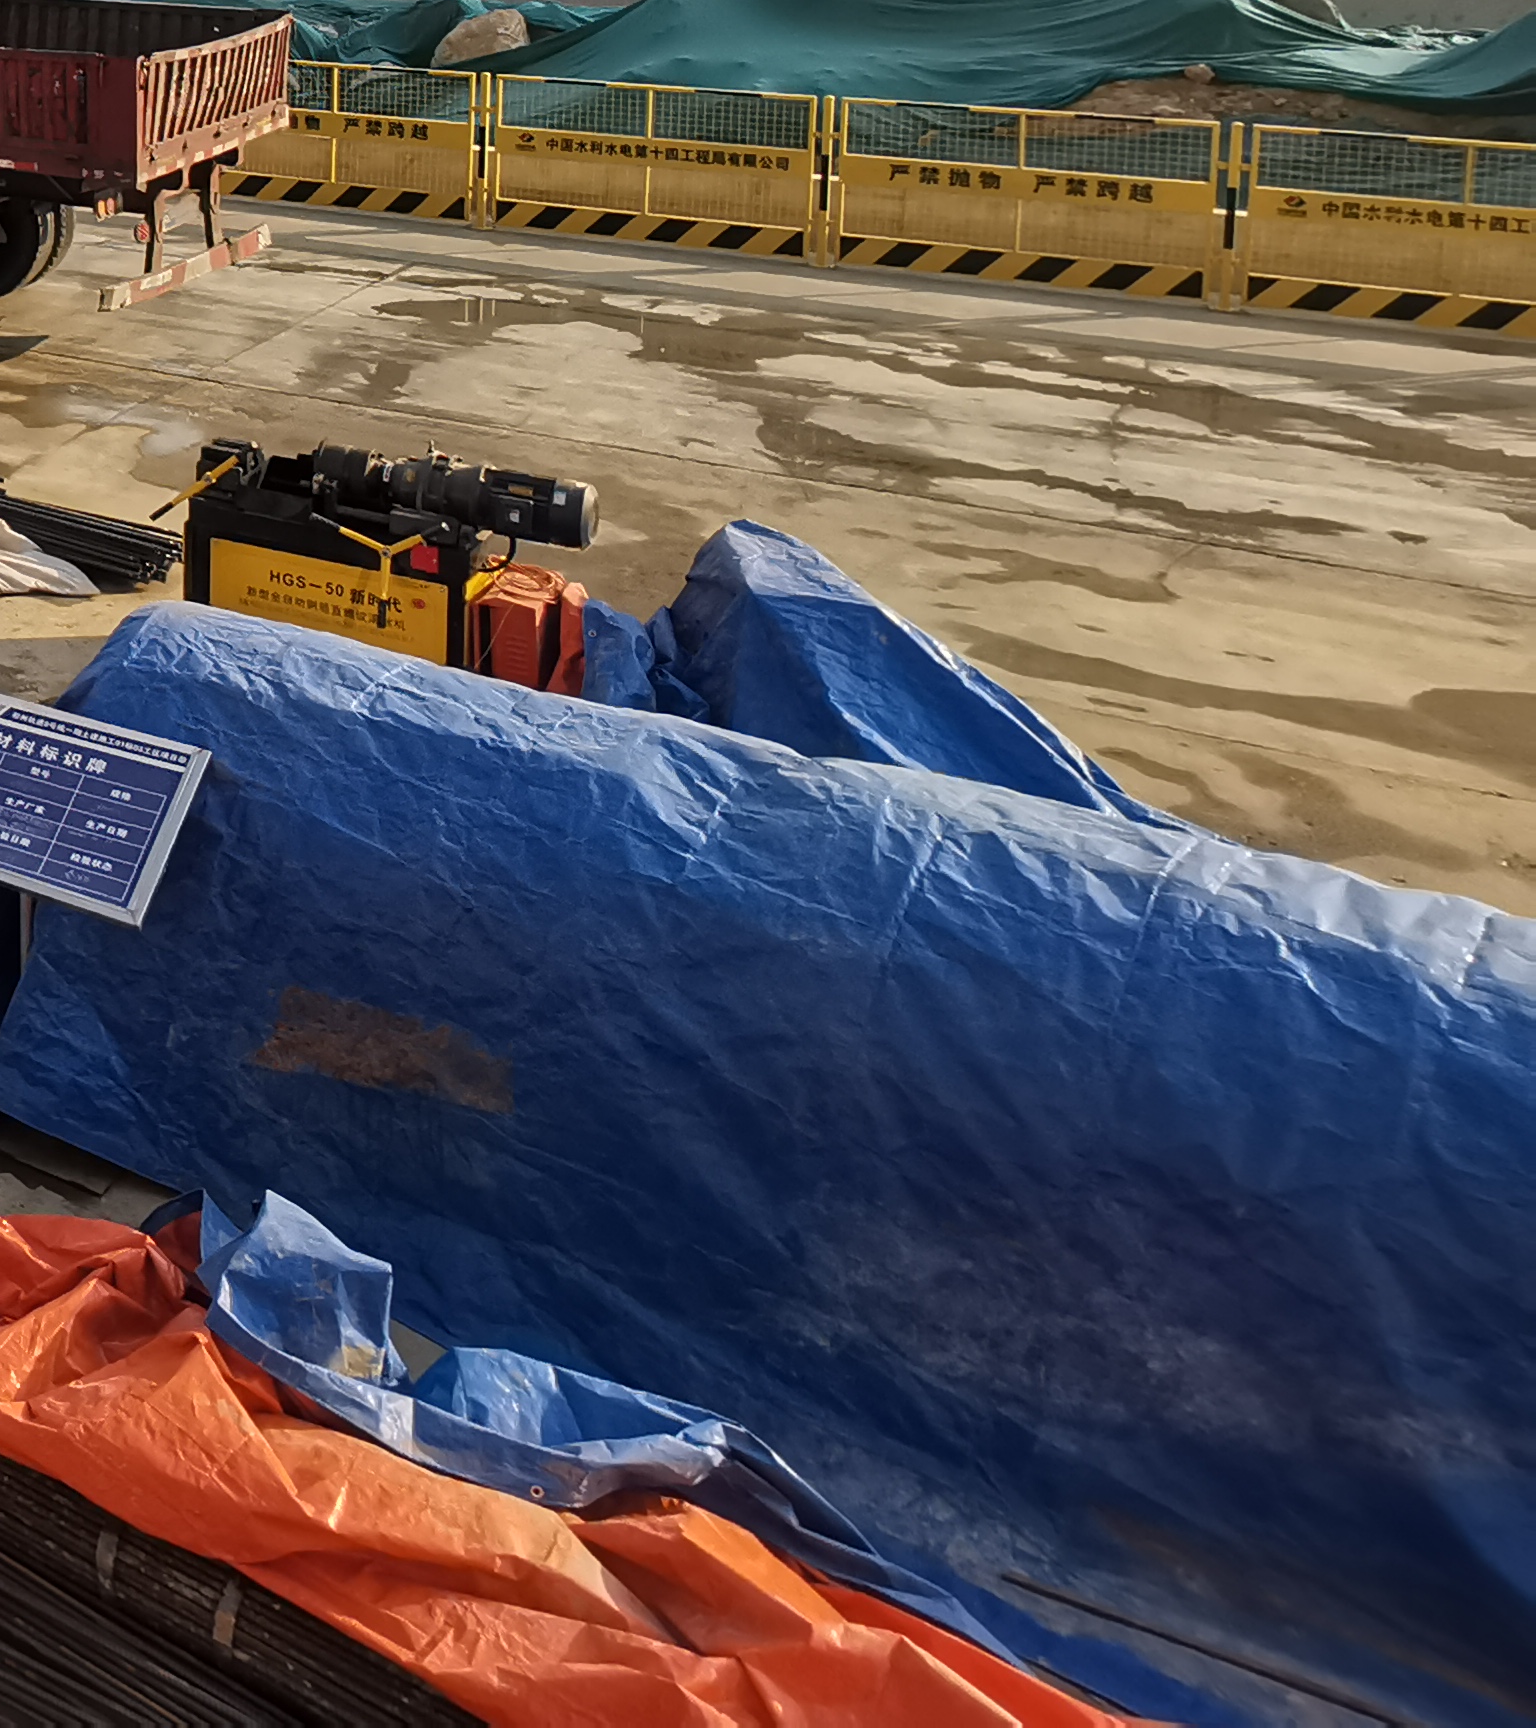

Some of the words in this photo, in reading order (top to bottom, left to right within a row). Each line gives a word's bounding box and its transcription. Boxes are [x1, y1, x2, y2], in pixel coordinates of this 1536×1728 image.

[342, 117, 429, 141] 严禁跨越
[545, 138, 790, 172] 中国水利水电第十四工程局有限公司
[889, 165, 1002, 190] 严禁抛物
[1033, 175, 1154, 203] 严禁跨越
[4, 796, 47, 816] 生产厂家
[85, 819, 129, 839] 生产日期
